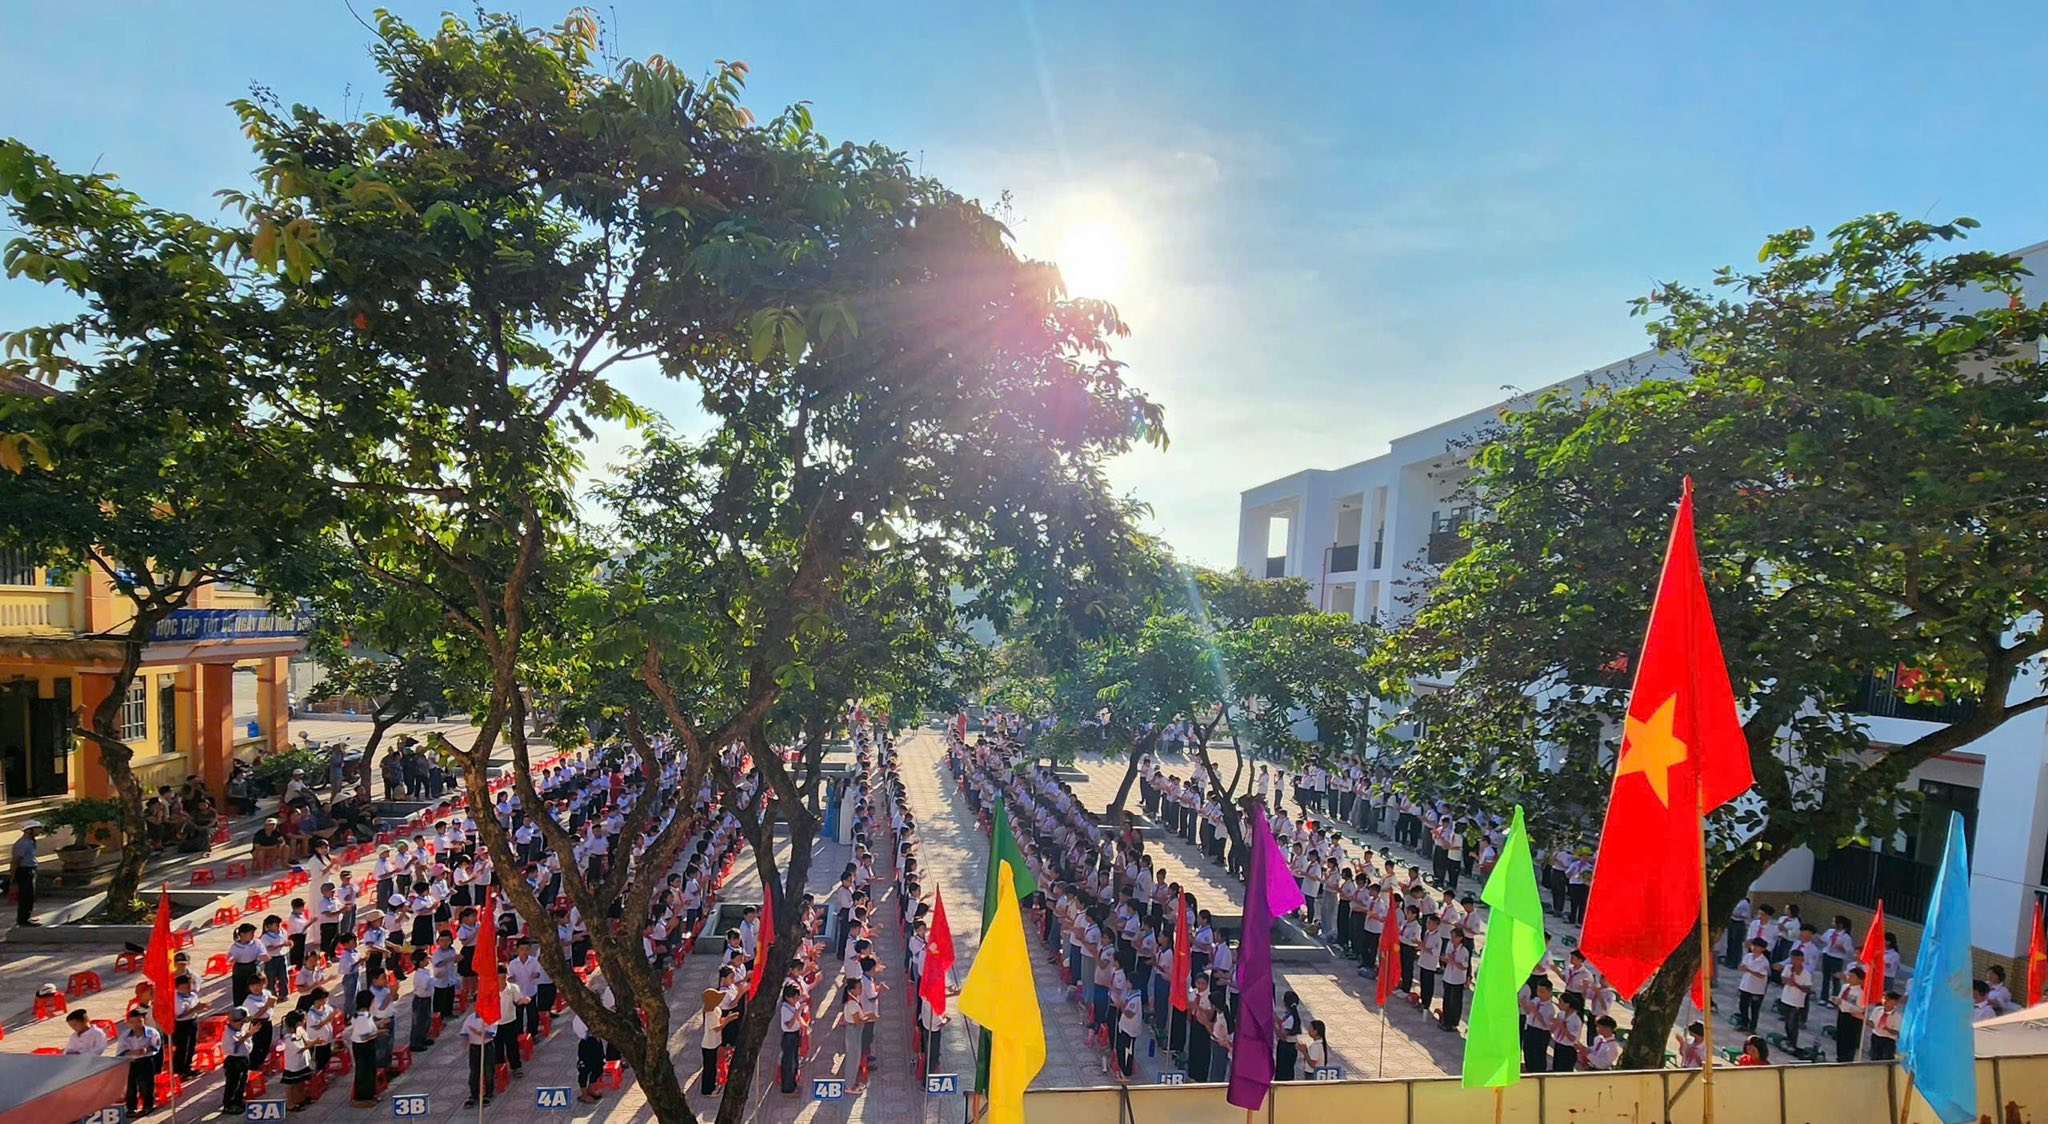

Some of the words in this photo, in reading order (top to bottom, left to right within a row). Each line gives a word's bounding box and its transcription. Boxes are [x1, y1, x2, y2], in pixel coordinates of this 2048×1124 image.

[156, 619, 178, 638] HỌC
[181, 616, 200, 636] TẬP
[1161, 1074, 1184, 1085] 5B
[1317, 1069, 1338, 1081] 6B
[815, 1083, 842, 1098] 4B
[928, 1077, 954, 1092] 5A
[395, 1098, 426, 1115] 3B
[537, 1090, 567, 1107] 4A
[247, 1103, 281, 1120] 3A
